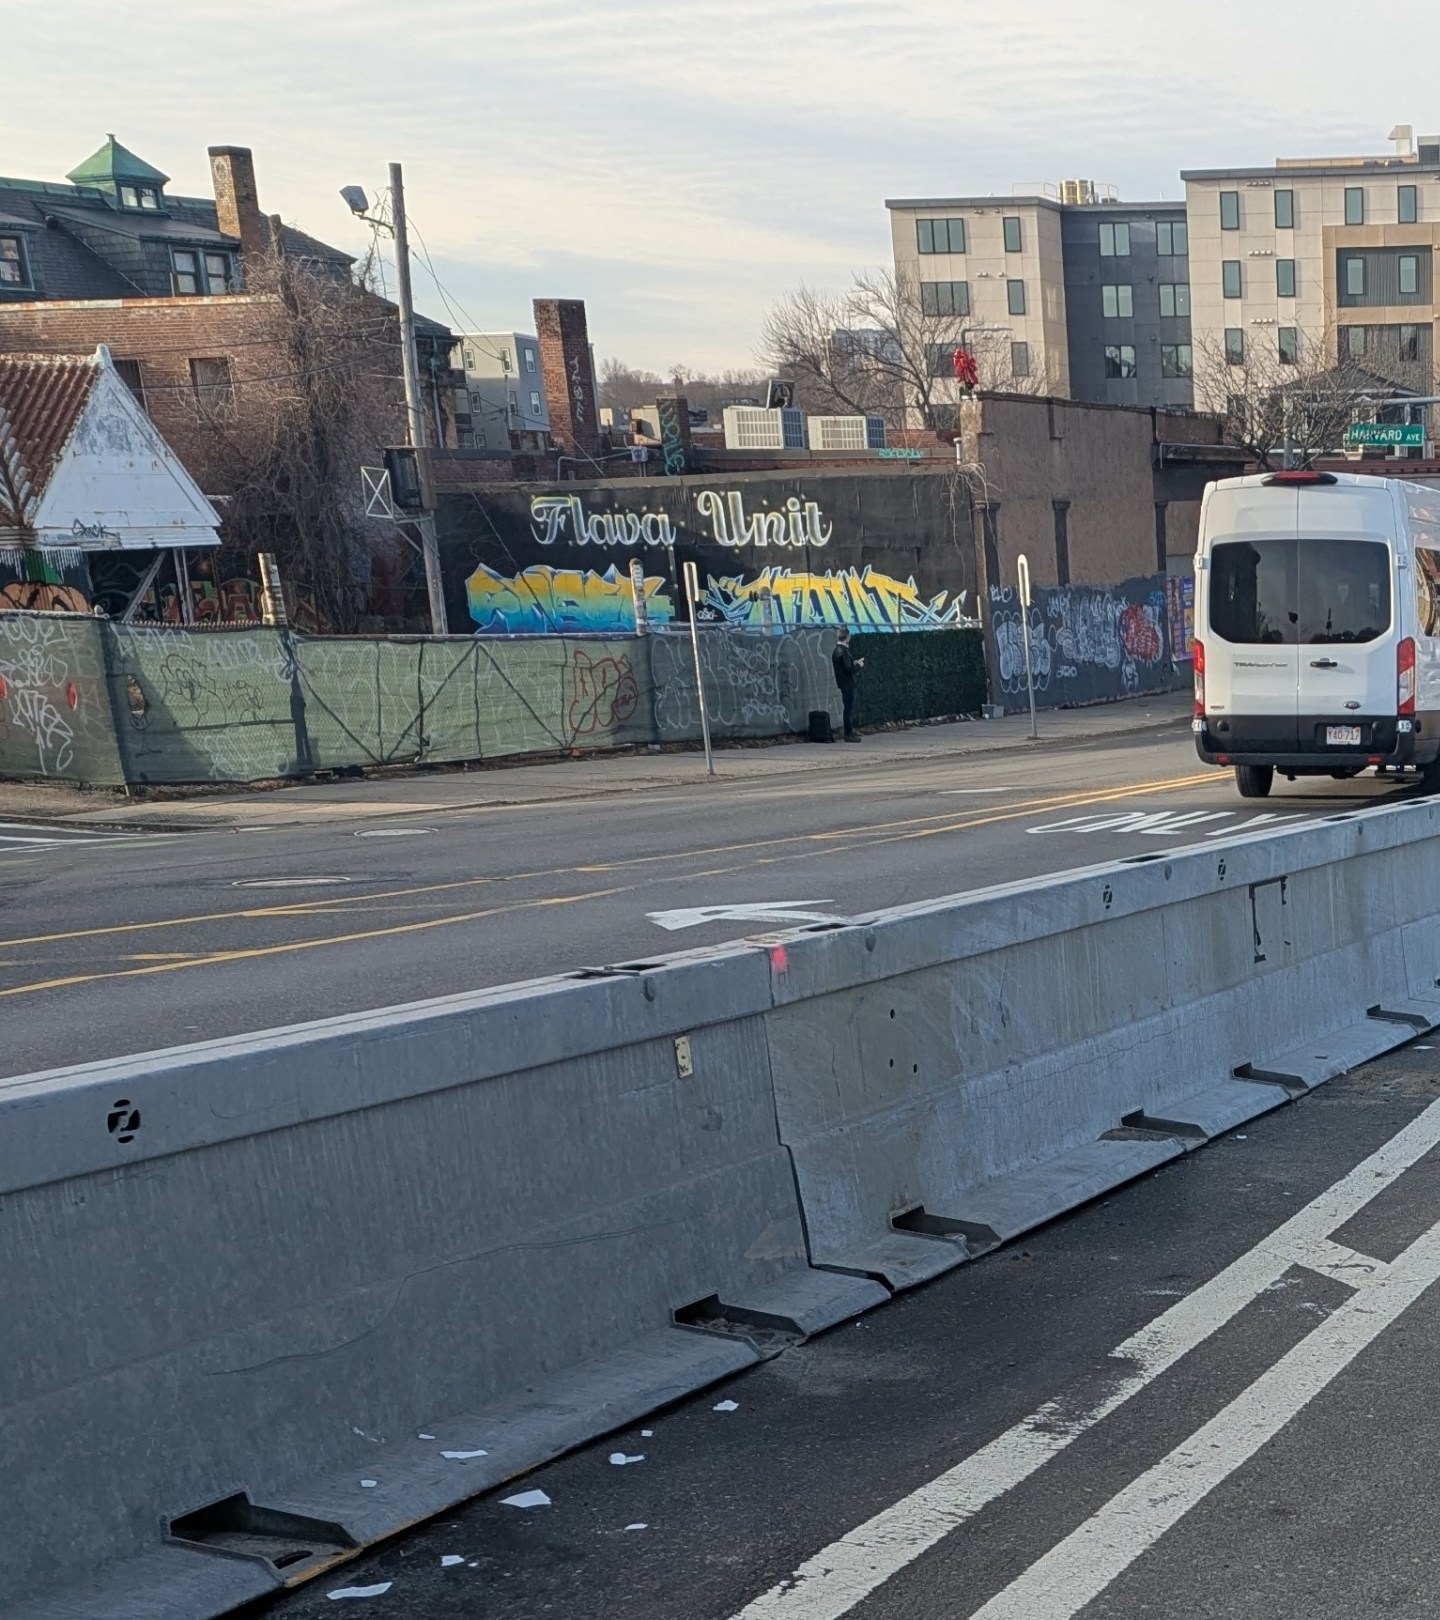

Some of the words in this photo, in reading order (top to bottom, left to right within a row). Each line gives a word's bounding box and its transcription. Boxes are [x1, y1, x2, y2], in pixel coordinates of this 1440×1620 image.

[1351, 429, 1402, 441] HARVARD
[1406, 433, 1420, 441] AVE
[530, 494, 676, 546] Flava
[697, 490, 833, 547] Unit
[1025, 810, 1311, 836] ONLY
